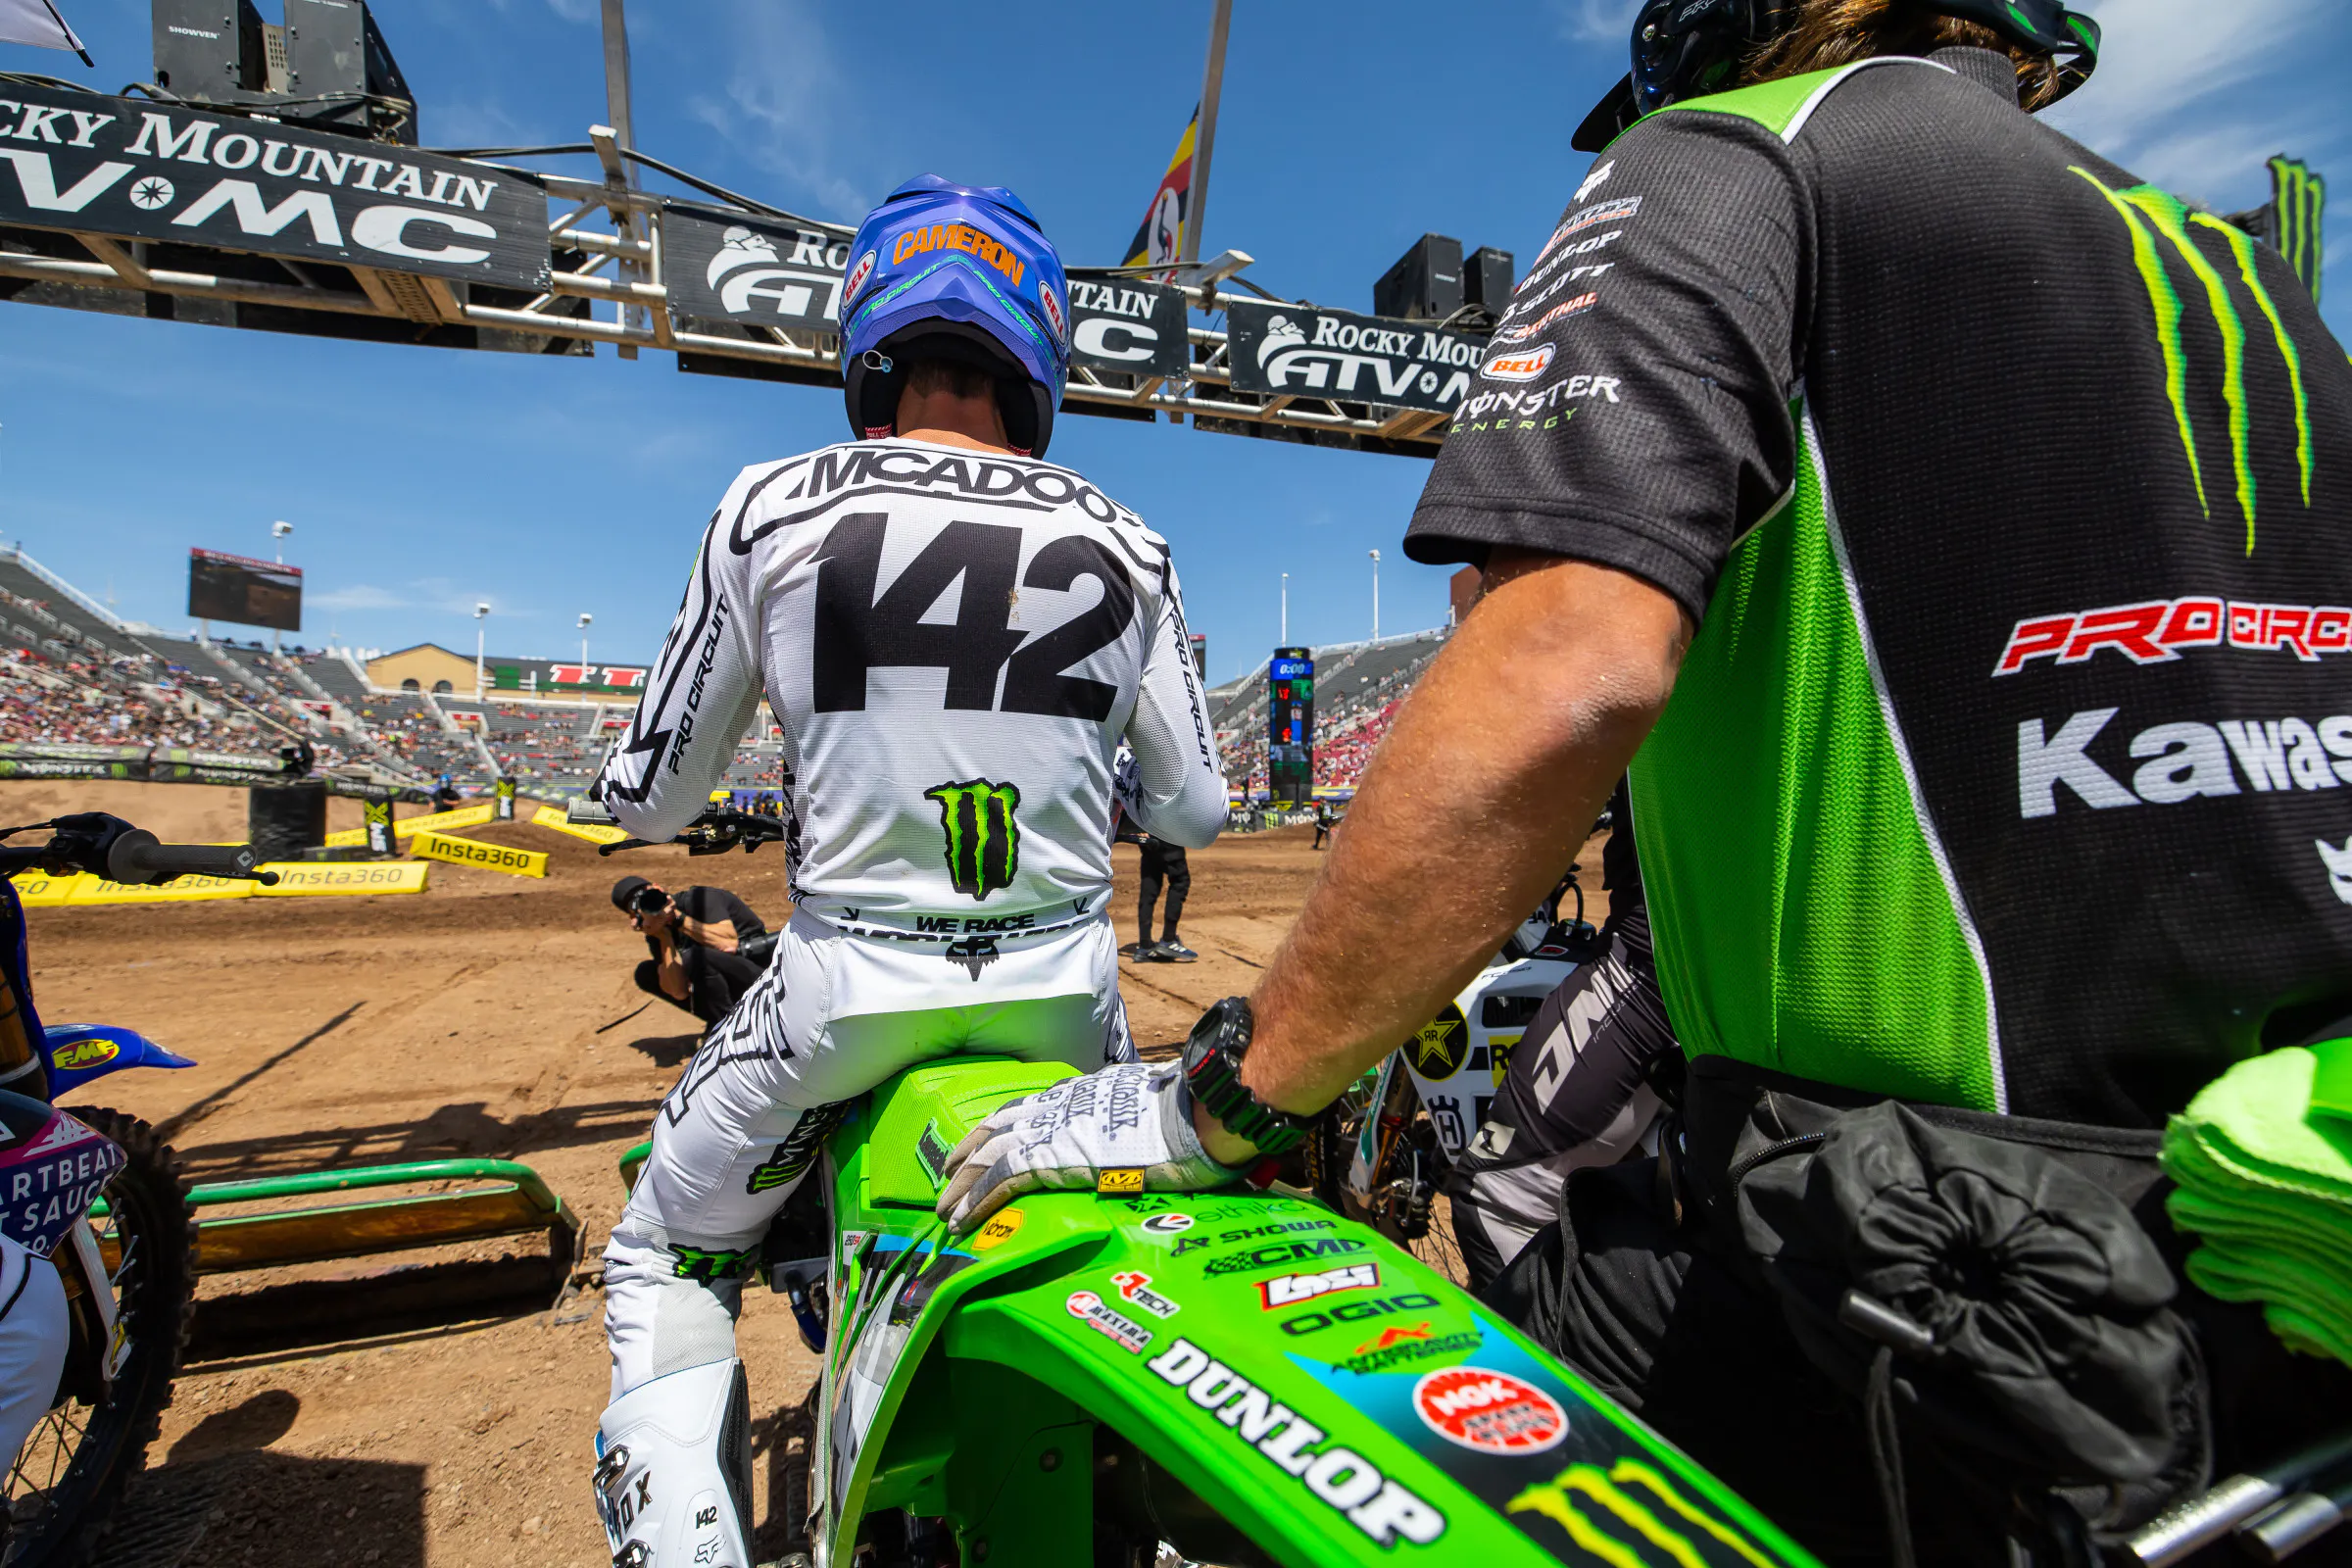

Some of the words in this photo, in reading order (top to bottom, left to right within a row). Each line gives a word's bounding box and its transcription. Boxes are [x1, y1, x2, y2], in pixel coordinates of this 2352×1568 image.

[169, 25, 218, 40] SHOWVEN
[124, 112, 498, 211] MOUNTAIN
[893, 223, 1025, 288] CAMERON
[1515, 229, 1623, 296] DUNLOP
[845, 261, 870, 302] BELL
[885, 262, 941, 302] CIRCUIT
[1517, 262, 1616, 317] SCOTT
[1001, 298, 1044, 346] CIRCUIT
[1044, 290, 1064, 338] BELL
[1512, 291, 1597, 339] RENTHAL
[1311, 316, 1414, 358] ROCKY
[1492, 353, 1545, 373] BELL
[1451, 407, 1578, 434] ENERGY
[807, 450, 1119, 525] MCADOO
[808, 512, 1136, 723] 142
[1991, 595, 2226, 677] PRO
[667, 710, 694, 776] PRO
[687, 592, 729, 713] CIRCUIT
[1169, 612, 1190, 667] PRO
[1183, 669, 1213, 774] CIRCUIT
[280, 862, 403, 885] Insta360
[430, 837, 530, 869] Insta360
[916, 915, 960, 933] WE
[963, 912, 1036, 933] RACE
[53, 1040, 116, 1069] FMF
[0, 1143, 117, 1205] RTBEAT
[982, 1219, 1016, 1239] Vibram
[1195, 1200, 1307, 1223] ethika
[1219, 1219, 1340, 1244] SHOWA
[1089, 1305, 1150, 1344] MAXIMA
[1280, 1292, 1442, 1337] OGIO
[1430, 1377, 1519, 1418] NGK
[1147, 1335, 1449, 1548] DUNLOP
[695, 1505, 718, 1530] 142
